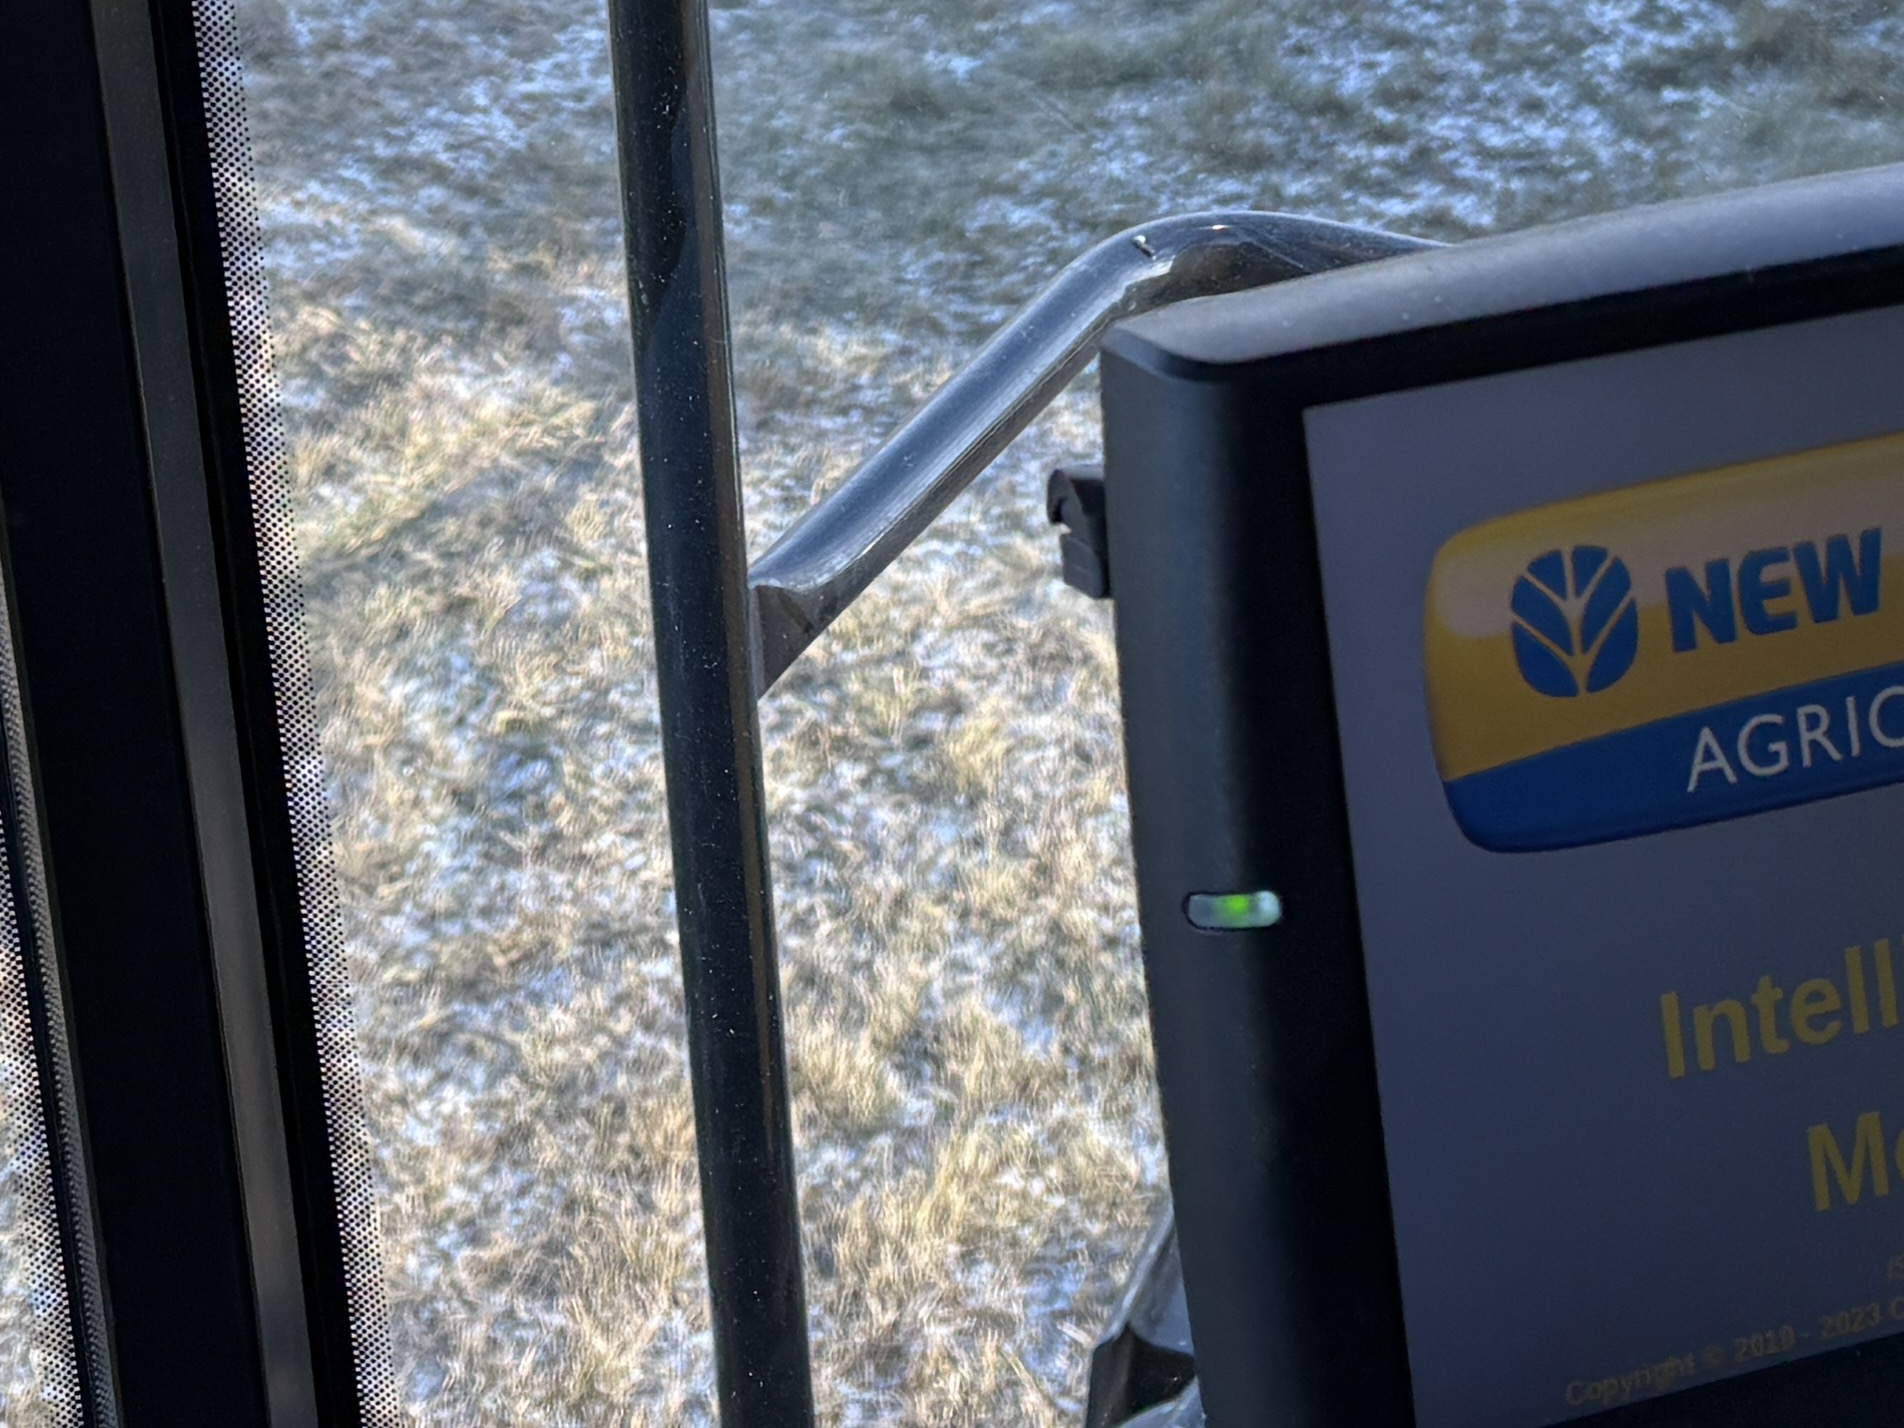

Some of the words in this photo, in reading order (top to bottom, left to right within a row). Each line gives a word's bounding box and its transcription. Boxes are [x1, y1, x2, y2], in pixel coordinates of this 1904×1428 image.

[1663, 526, 1882, 653] NEW
[1565, 1349, 1697, 1406] Copyright
[1818, 1301, 1882, 1339] 2023
